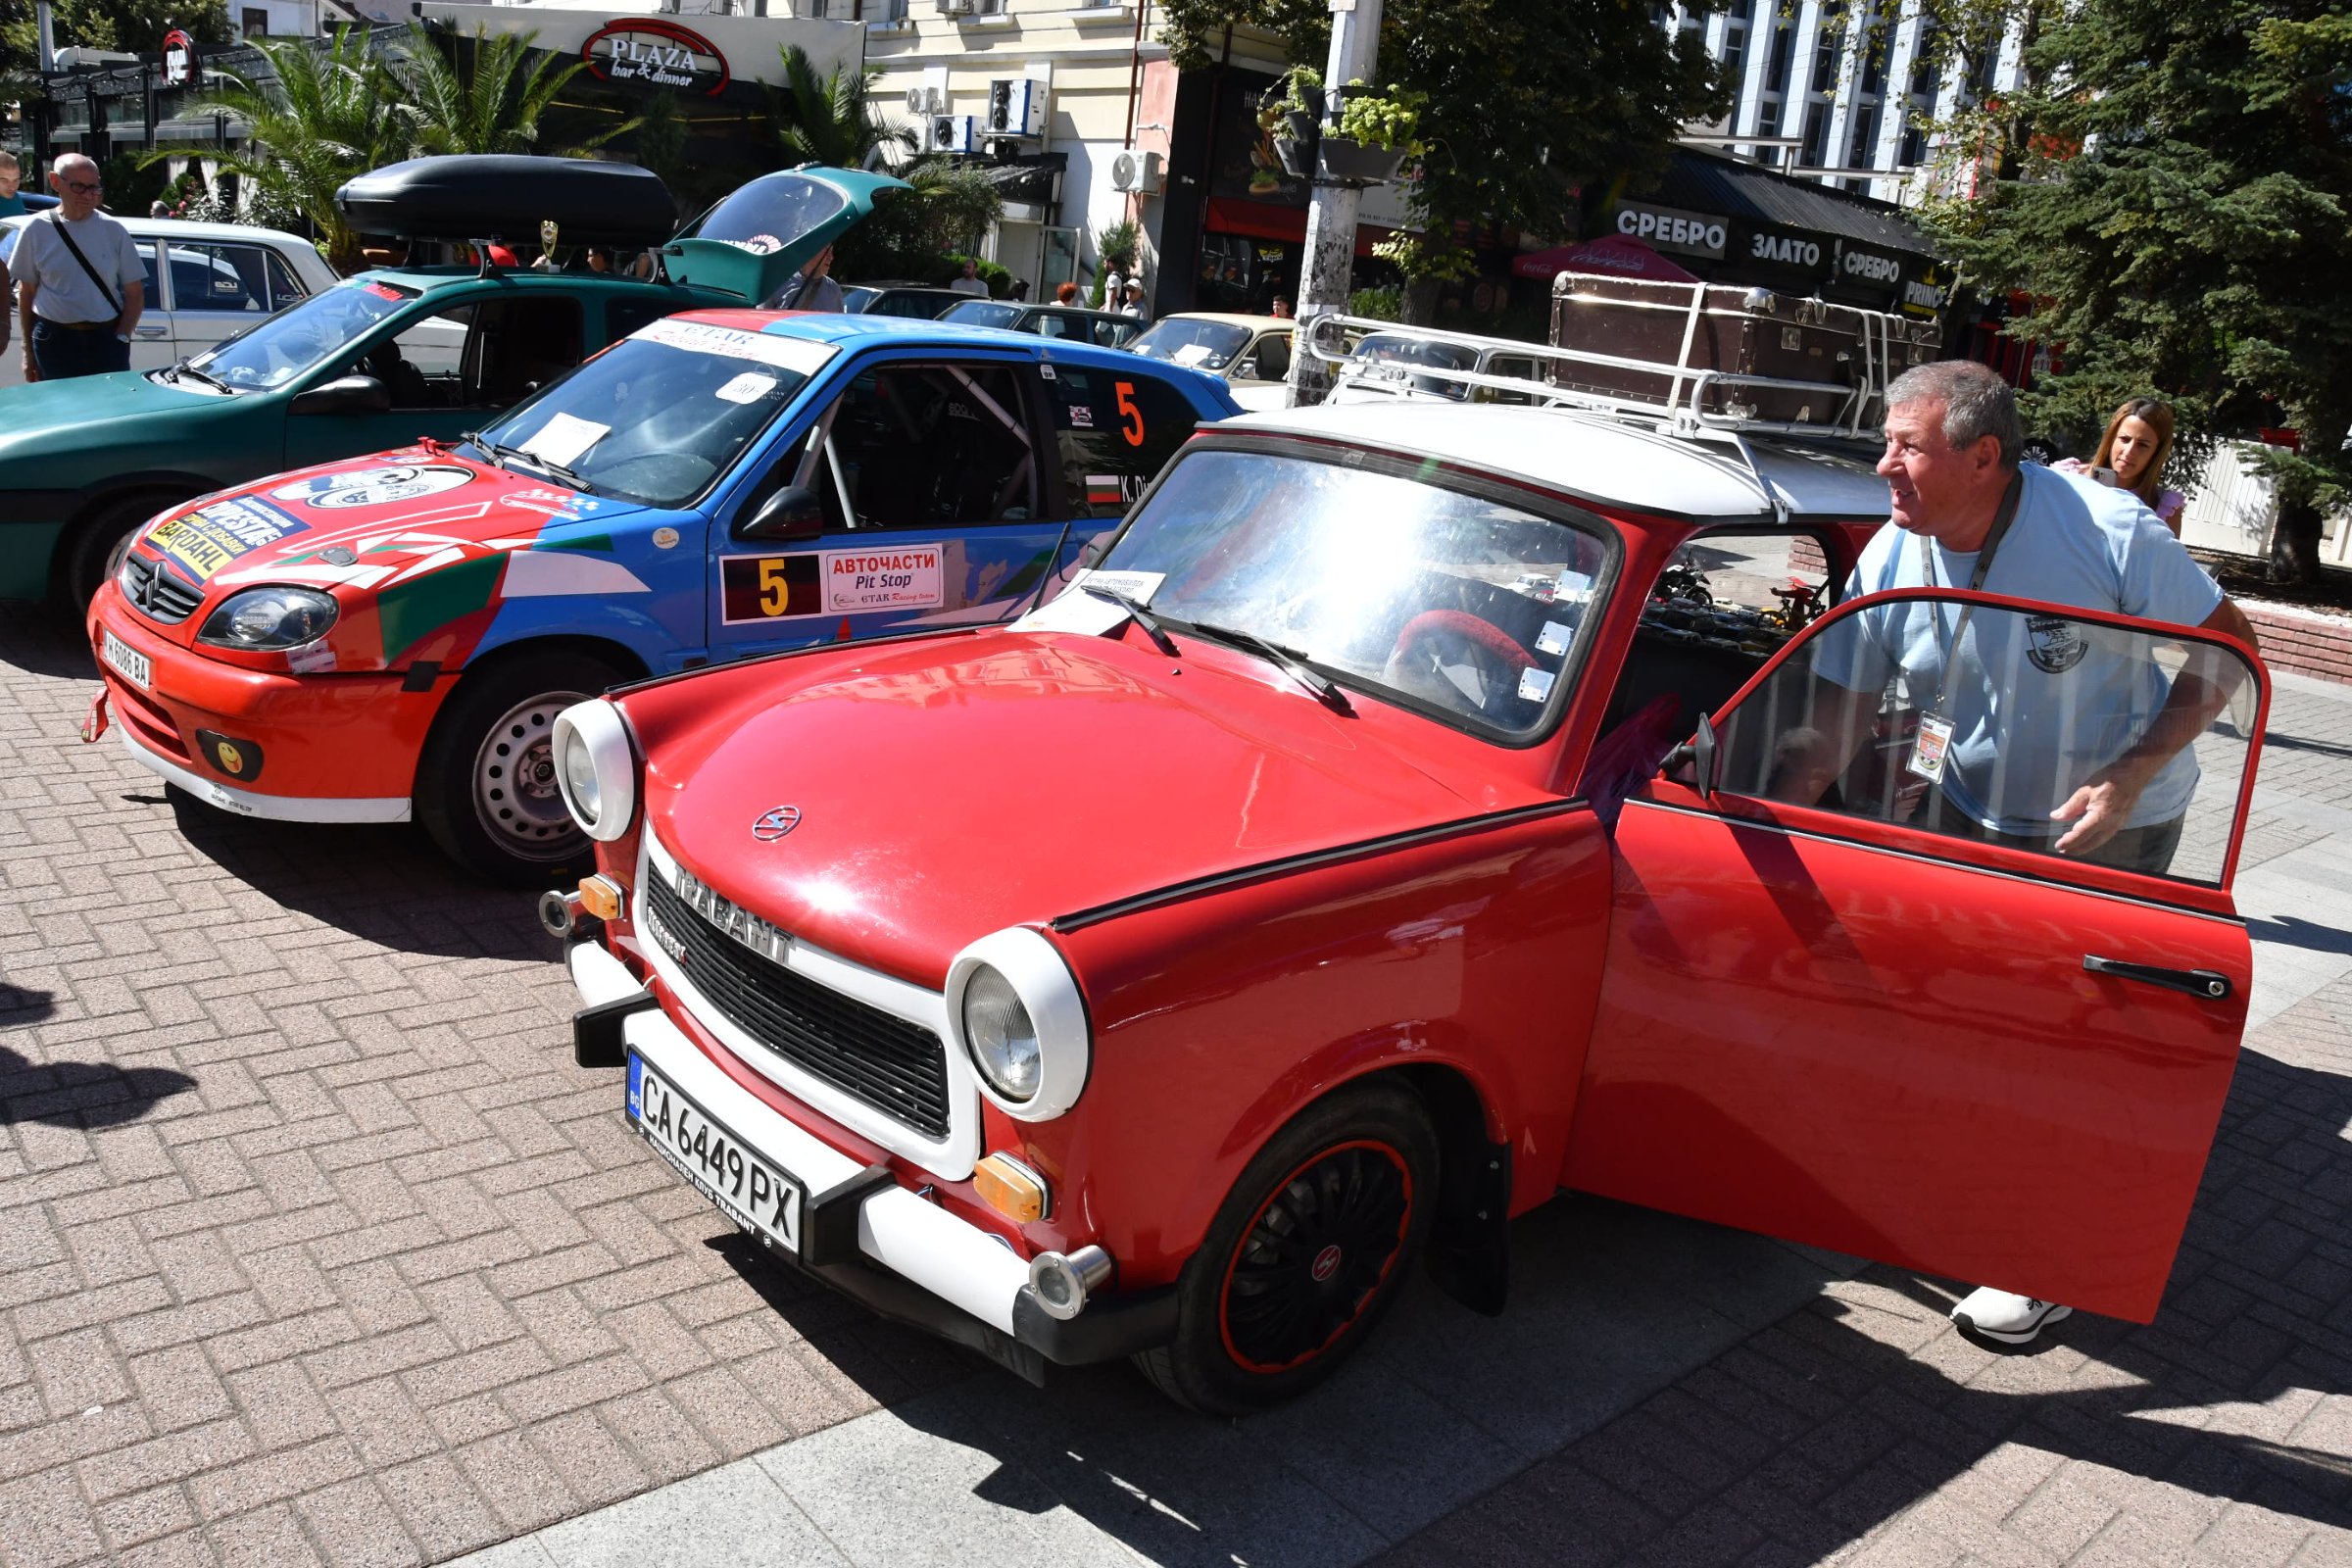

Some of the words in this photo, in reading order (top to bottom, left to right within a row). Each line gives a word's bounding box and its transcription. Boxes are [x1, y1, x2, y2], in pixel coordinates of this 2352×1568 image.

[610, 39, 697, 71] PLAZA
[611, 58, 635, 77] bar
[637, 62, 651, 79] &
[652, 67, 693, 86] dinner
[1618, 210, 1726, 249] СРЕБРО
[1751, 233, 1820, 267] ЗЛАТО
[1844, 251, 1900, 283] СРЕБРО
[1114, 381, 1145, 447] 5
[1121, 475, 1134, 503] K.
[156, 522, 223, 572] BARDAHL
[204, 528, 248, 555] ДОБАВКИ
[833, 554, 936, 575] АВТОЧАСТИ
[855, 575, 875, 590] Pit
[880, 572, 912, 588] Stop
[759, 559, 789, 617] 5
[892, 592, 917, 602] Racing
[108, 634, 114, 661] H
[115, 642, 132, 675] 6086
[134, 656, 147, 685] BA
[675, 865, 796, 966] TRABANT
[630, 1090, 640, 1109] BG
[644, 1074, 673, 1143] CA
[678, 1108, 744, 1199] 6449
[750, 1161, 792, 1241] PX
[649, 1134, 695, 1182] НАЦИОНАЛЕН
[694, 1177, 714, 1200] КЛУБ
[714, 1194, 757, 1235] TRABANT
